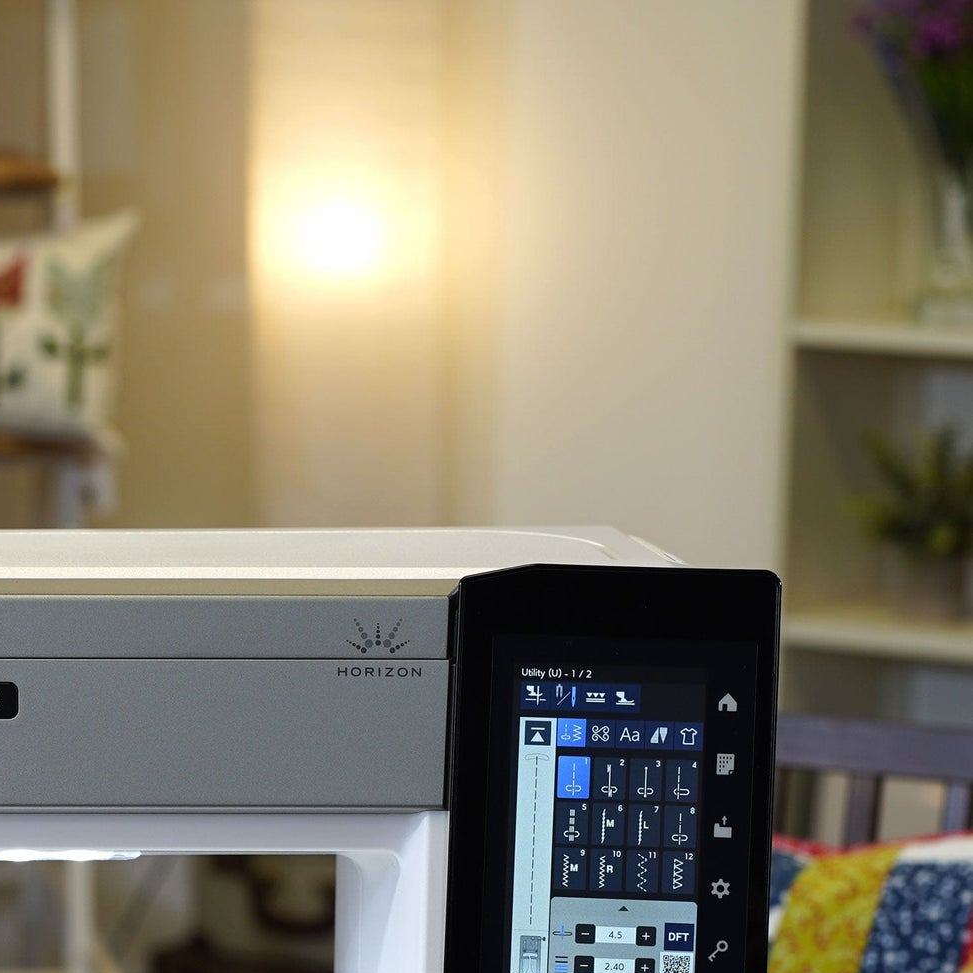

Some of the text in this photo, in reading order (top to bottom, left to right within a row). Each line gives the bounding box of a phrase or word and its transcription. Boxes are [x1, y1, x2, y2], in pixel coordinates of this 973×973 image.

[337, 667, 422, 677] HORIZON
[521, 668, 546, 679] Utility
[548, 668, 562, 679] (U)
[586, 670, 592, 679] 2
[620, 727, 640, 742] Aa
[692, 761, 697, 769] 4
[690, 807, 695, 815] 8
[606, 819, 615, 827] M
[644, 821, 649, 829] L
[613, 850, 621, 858] 10
[649, 851, 657, 859] 11
[685, 852, 694, 860] 12
[570, 864, 578, 872] M
[607, 865, 614, 873] R
[608, 931, 622, 939] 4.5
[668, 932, 689, 942] DFT
[604, 963, 625, 971] 2.40
